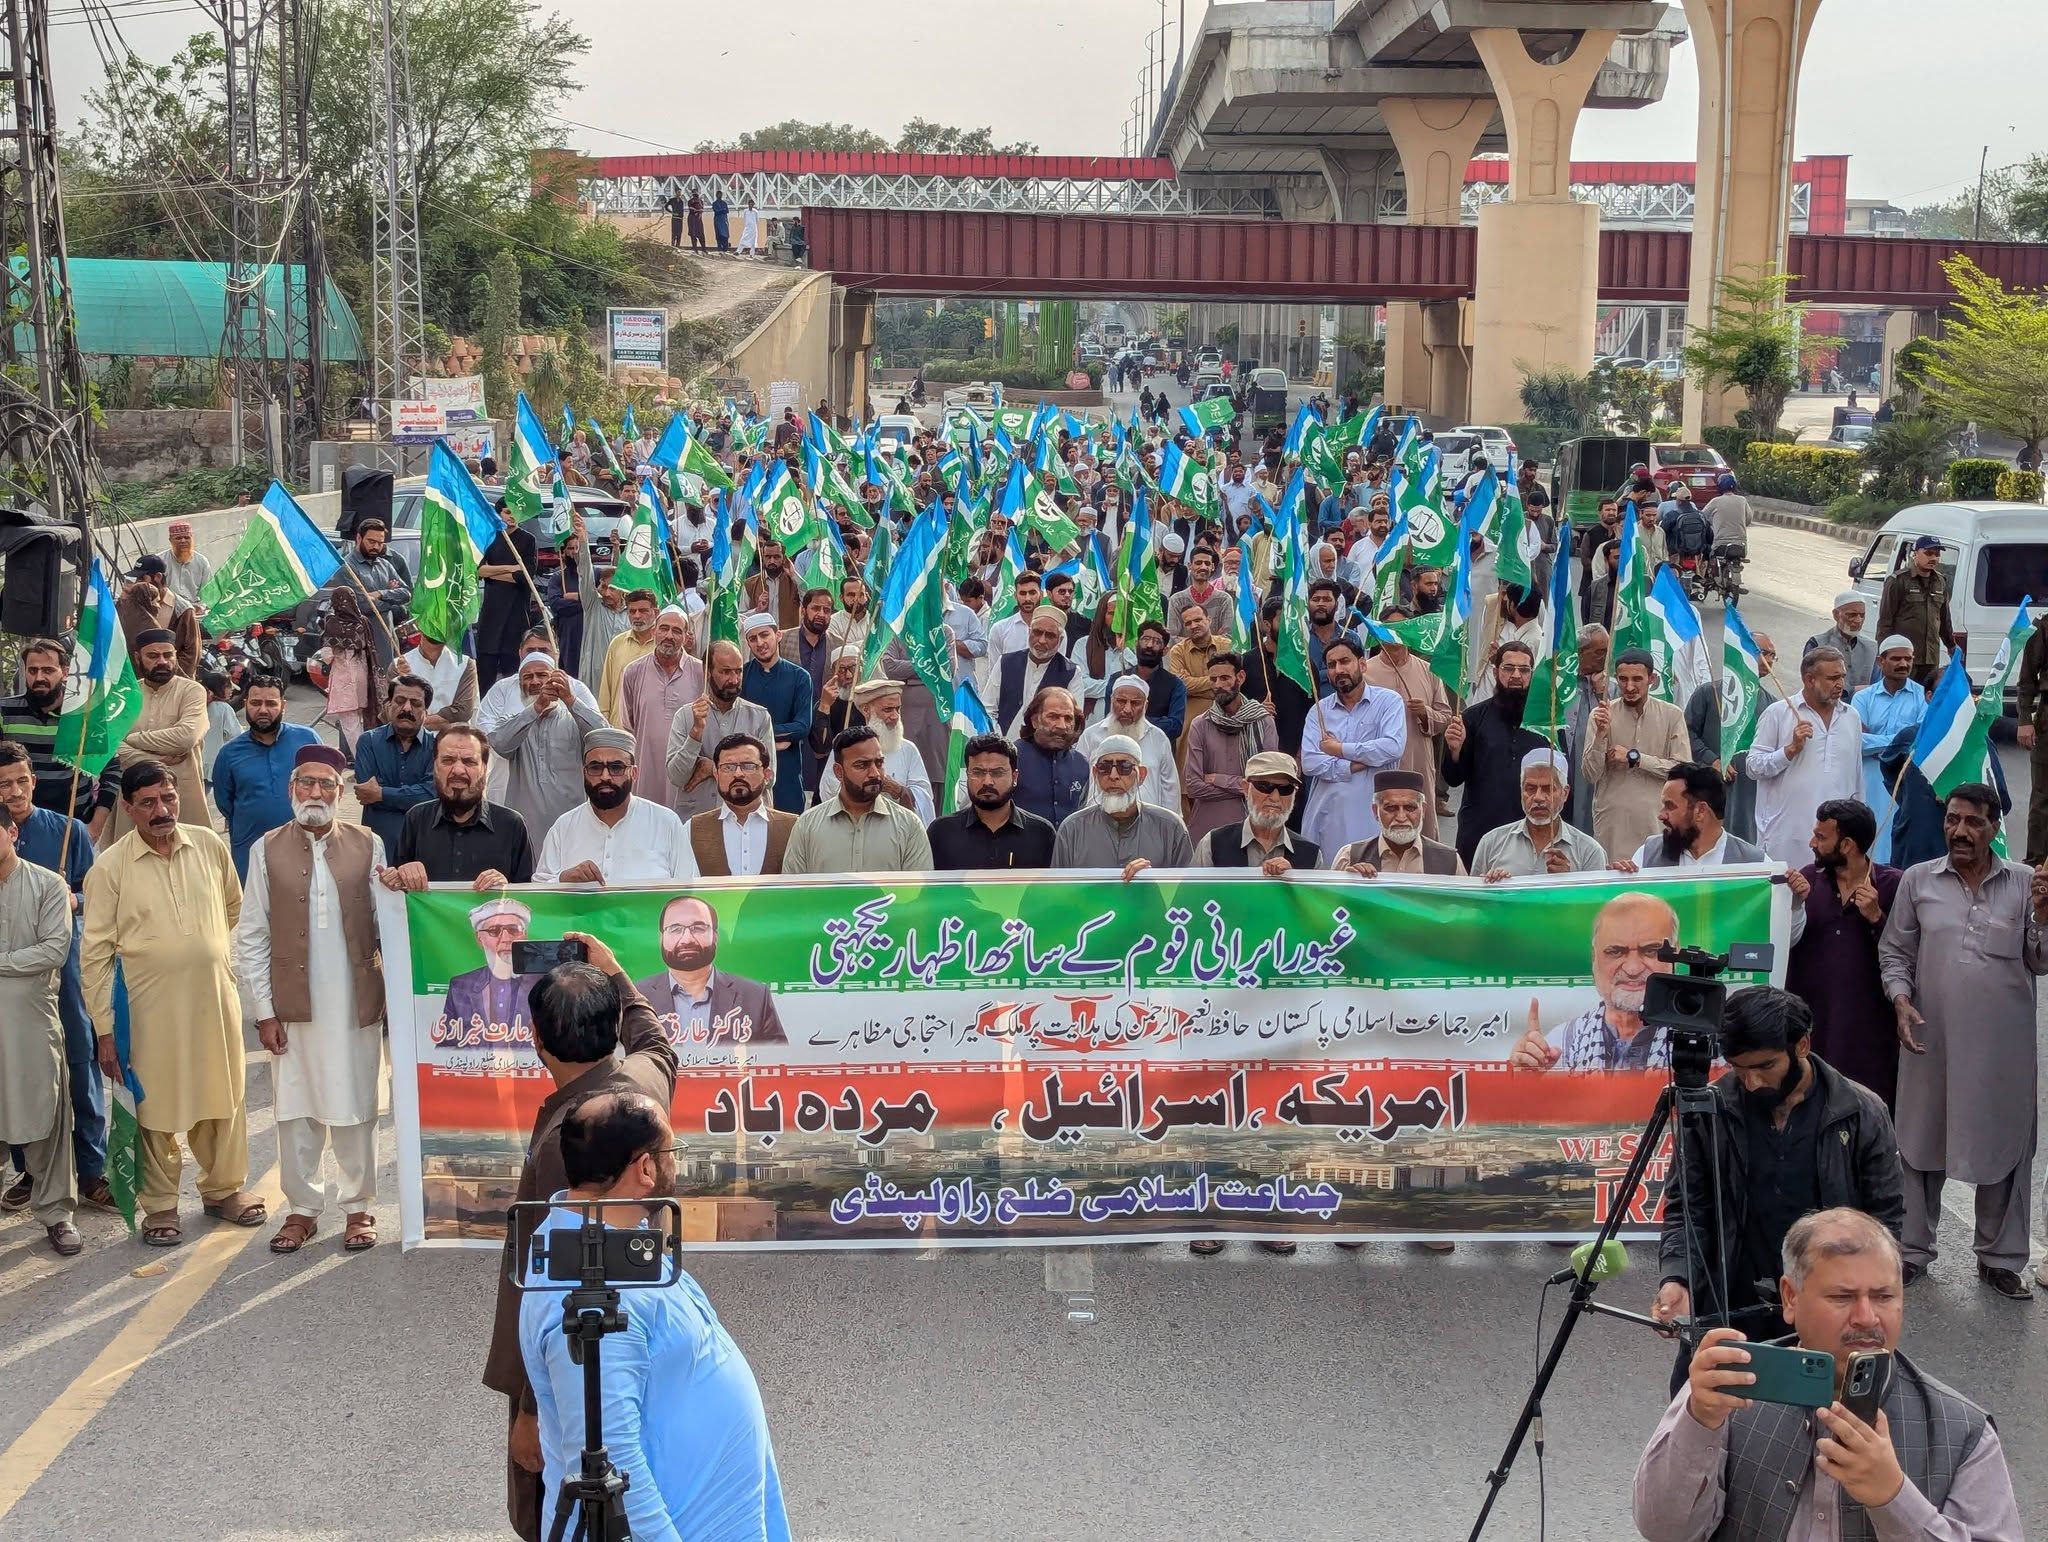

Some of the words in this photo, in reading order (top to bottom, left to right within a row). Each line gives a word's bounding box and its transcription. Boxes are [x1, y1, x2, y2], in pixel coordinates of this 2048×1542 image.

[879, 916, 977, 987] اظہار
[972, 918, 1066, 976] ساتھ
[1058, 910, 1123, 975] کے
[1124, 906, 1193, 998] قوم
[1190, 900, 1286, 988] ایرانی
[1279, 906, 1356, 975] غیور
[430, 1012, 485, 1048] شیرازی
[708, 1006, 753, 1050] ڈاکٹر
[808, 1017, 892, 1051] مظاہرے
[892, 1013, 955, 1053] احتجاجی
[953, 1000, 995, 1048] گیر
[985, 1002, 1024, 1038] ملک
[1023, 1016, 1041, 1049] پر
[1043, 1010, 1101, 1047] ہدایت
[1103, 999, 1131, 1041] کی
[1180, 998, 1212, 1051] نعیم
[1207, 1009, 1251, 1037] حافظ
[1257, 999, 1330, 1050] پاکستان
[1332, 1004, 1395, 1040] اسلامی
[1394, 1010, 1469, 1037] جماعت
[1465, 1009, 1510, 1045] امیر
[704, 1075, 785, 1150] باد
[794, 1085, 939, 1150] مردہ
[1275, 1069, 1468, 1143] امریکہ
[1556, 1136, 1613, 1162] WE
[830, 1171, 992, 1231] راولپنڈی
[994, 1176, 1077, 1225] ضلع
[1079, 1171, 1210, 1223] اسلامی
[1213, 1172, 1344, 1221] جماعت
